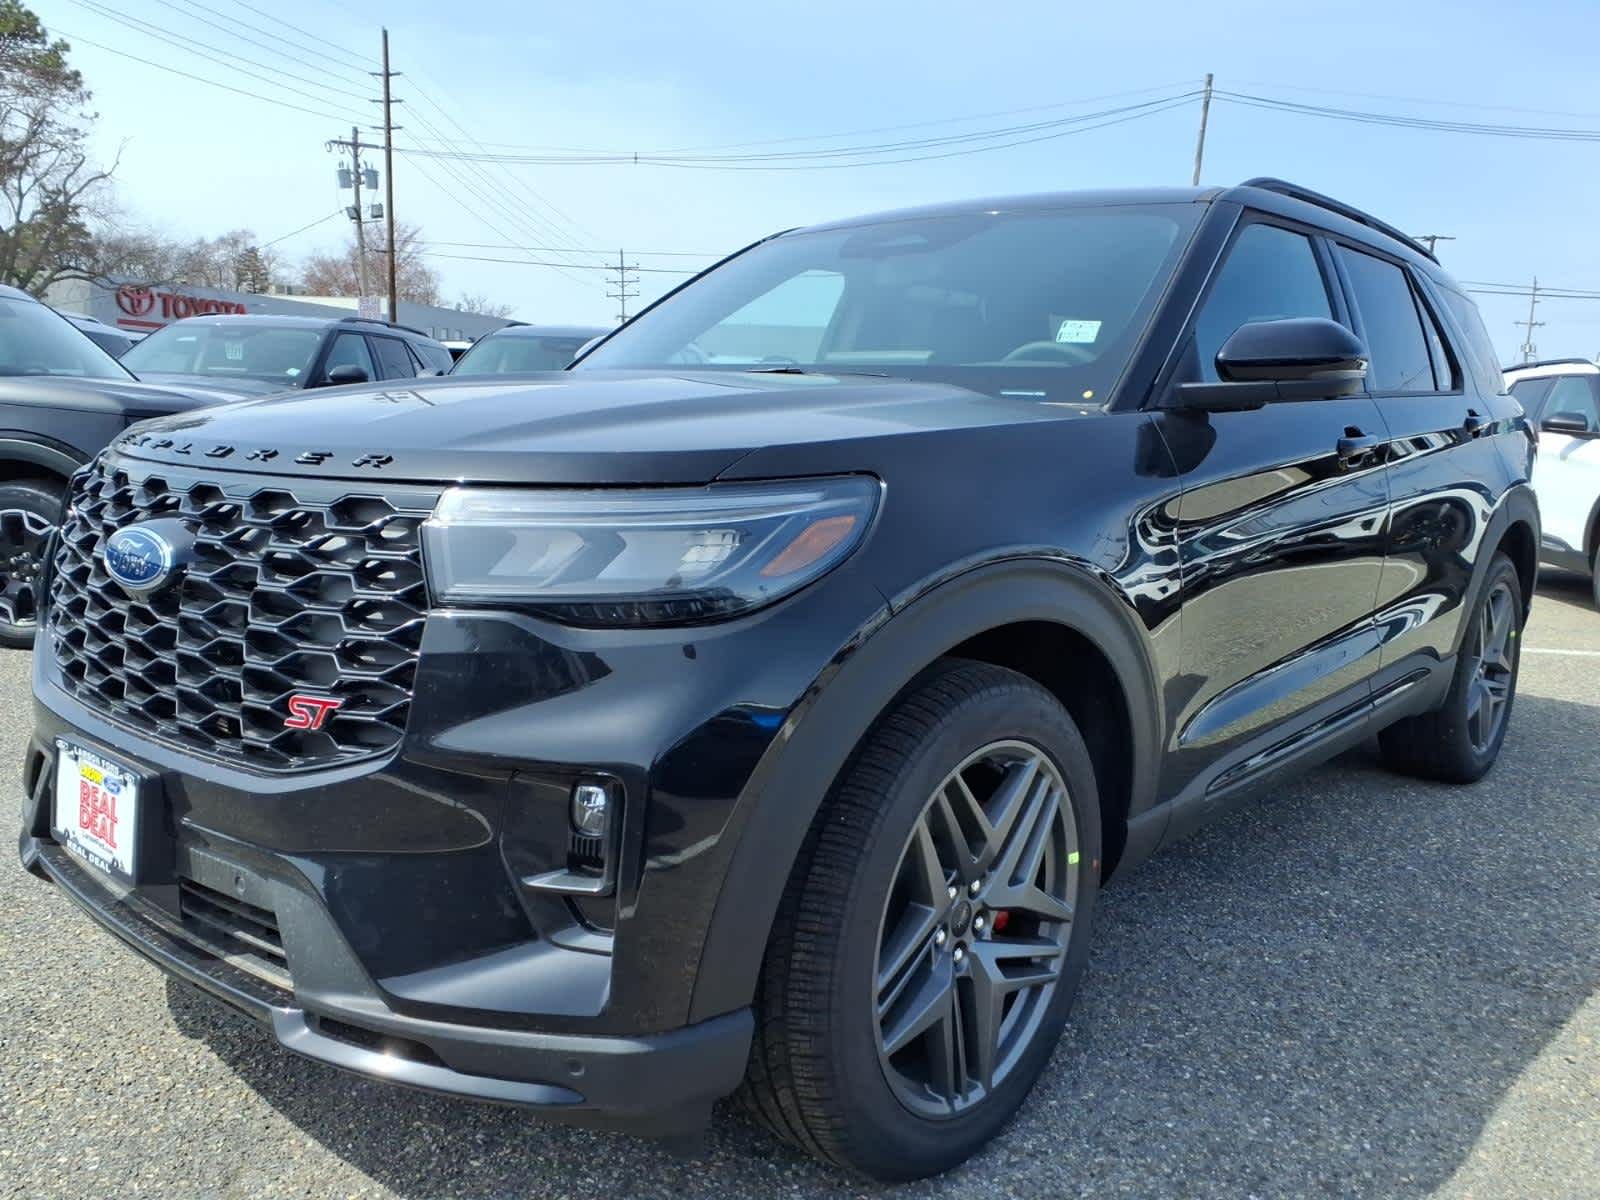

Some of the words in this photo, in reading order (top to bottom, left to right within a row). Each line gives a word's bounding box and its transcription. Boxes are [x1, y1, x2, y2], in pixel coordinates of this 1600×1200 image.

[157, 292, 248, 319] TOYOTA
[283, 694, 344, 730] ST
[80, 780, 118, 823] REAL
[80, 805, 117, 849] DEAL
[88, 852, 111, 873] DEAL
